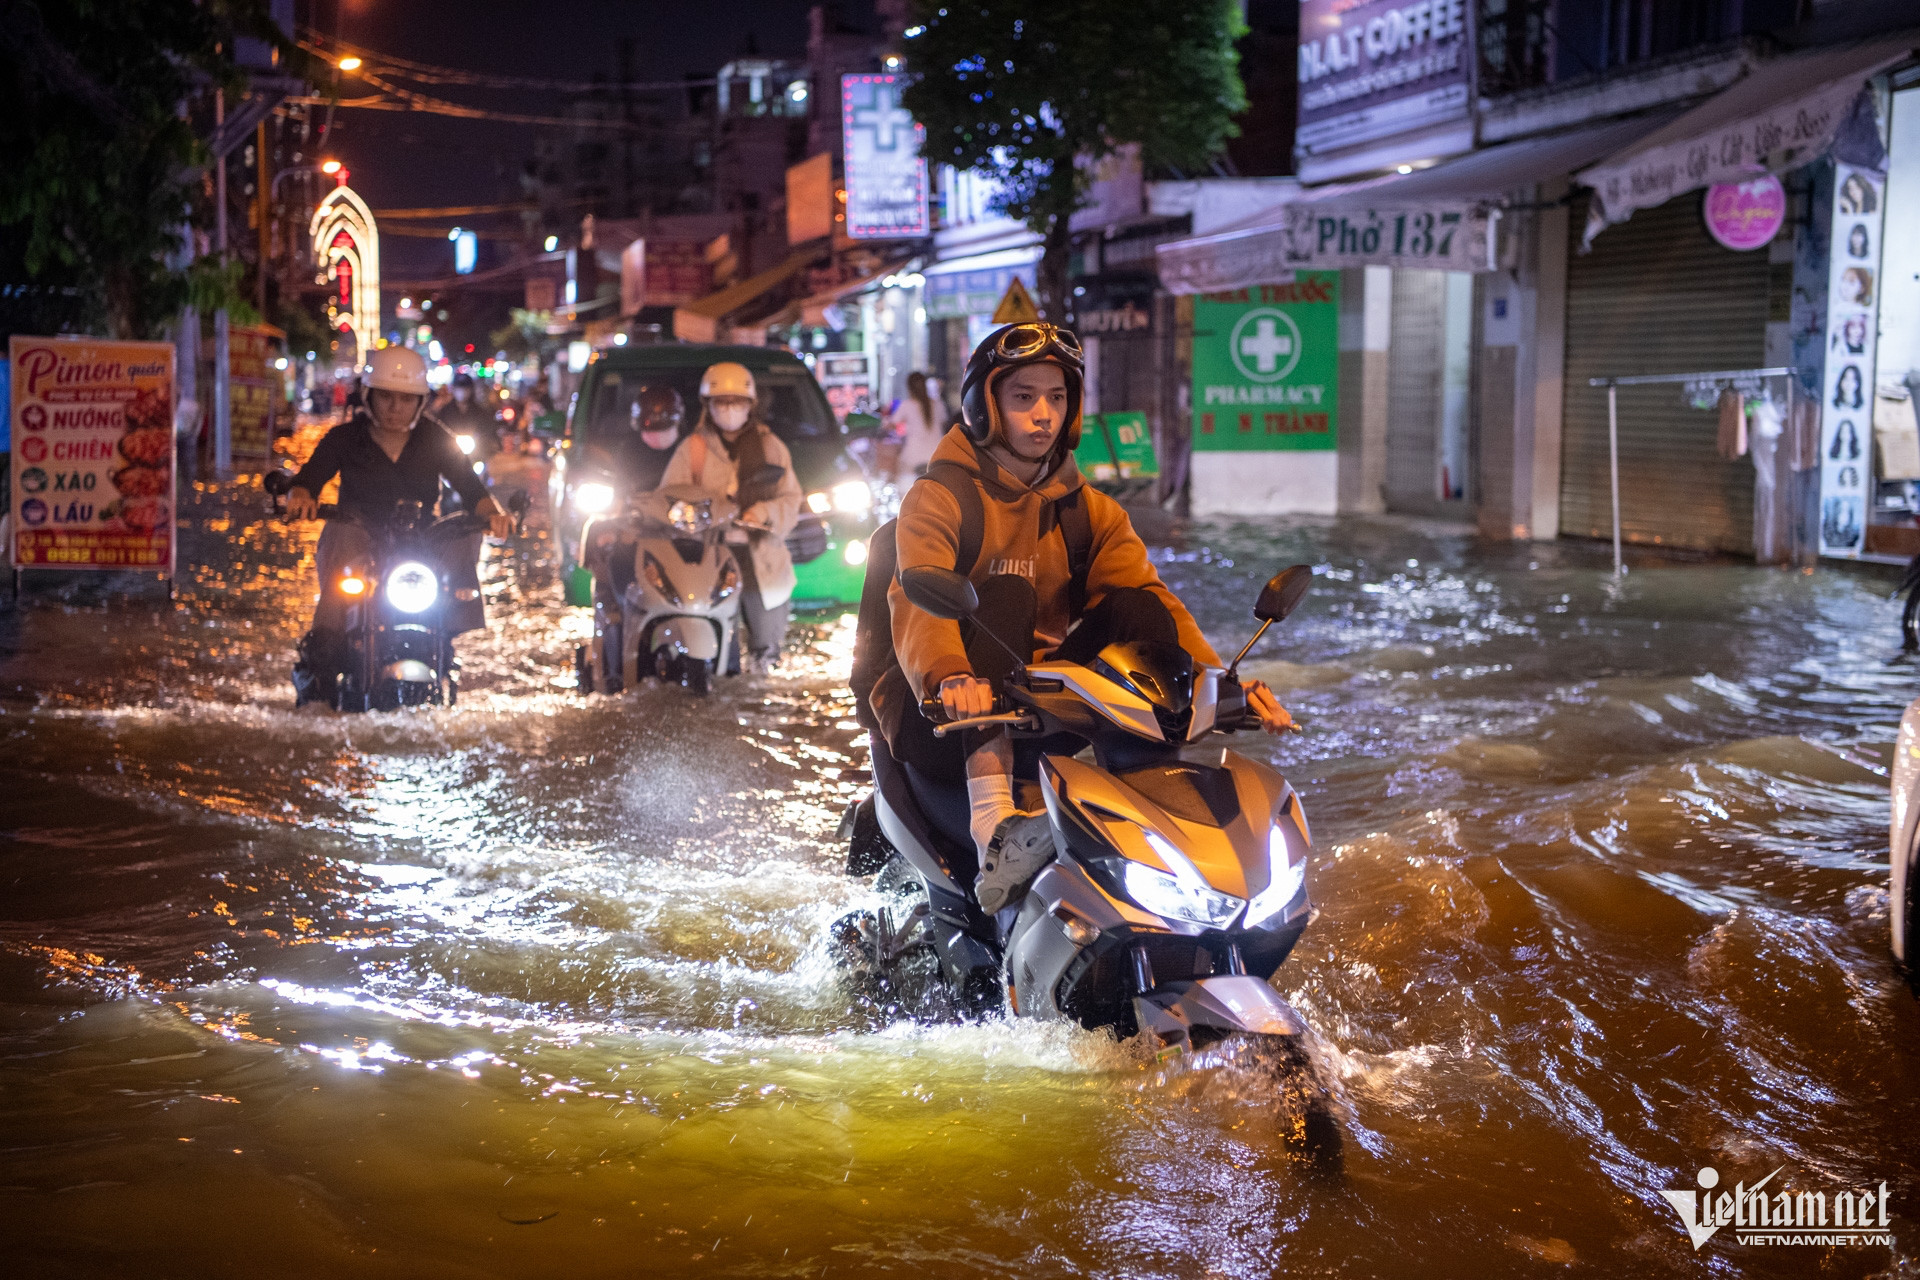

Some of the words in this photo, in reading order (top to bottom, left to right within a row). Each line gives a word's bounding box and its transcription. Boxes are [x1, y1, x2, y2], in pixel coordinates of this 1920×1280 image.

[1364, 0, 1465, 60] COFFEE
[1316, 208, 1384, 255] Phở
[1394, 212, 1461, 258] 137
[18, 348, 122, 395] Pimon
[127, 362, 166, 383] quán
[1204, 384, 1325, 405] PHARMACY
[53, 408, 122, 429] NƯỚNG
[53, 438, 113, 460] CHIÊN
